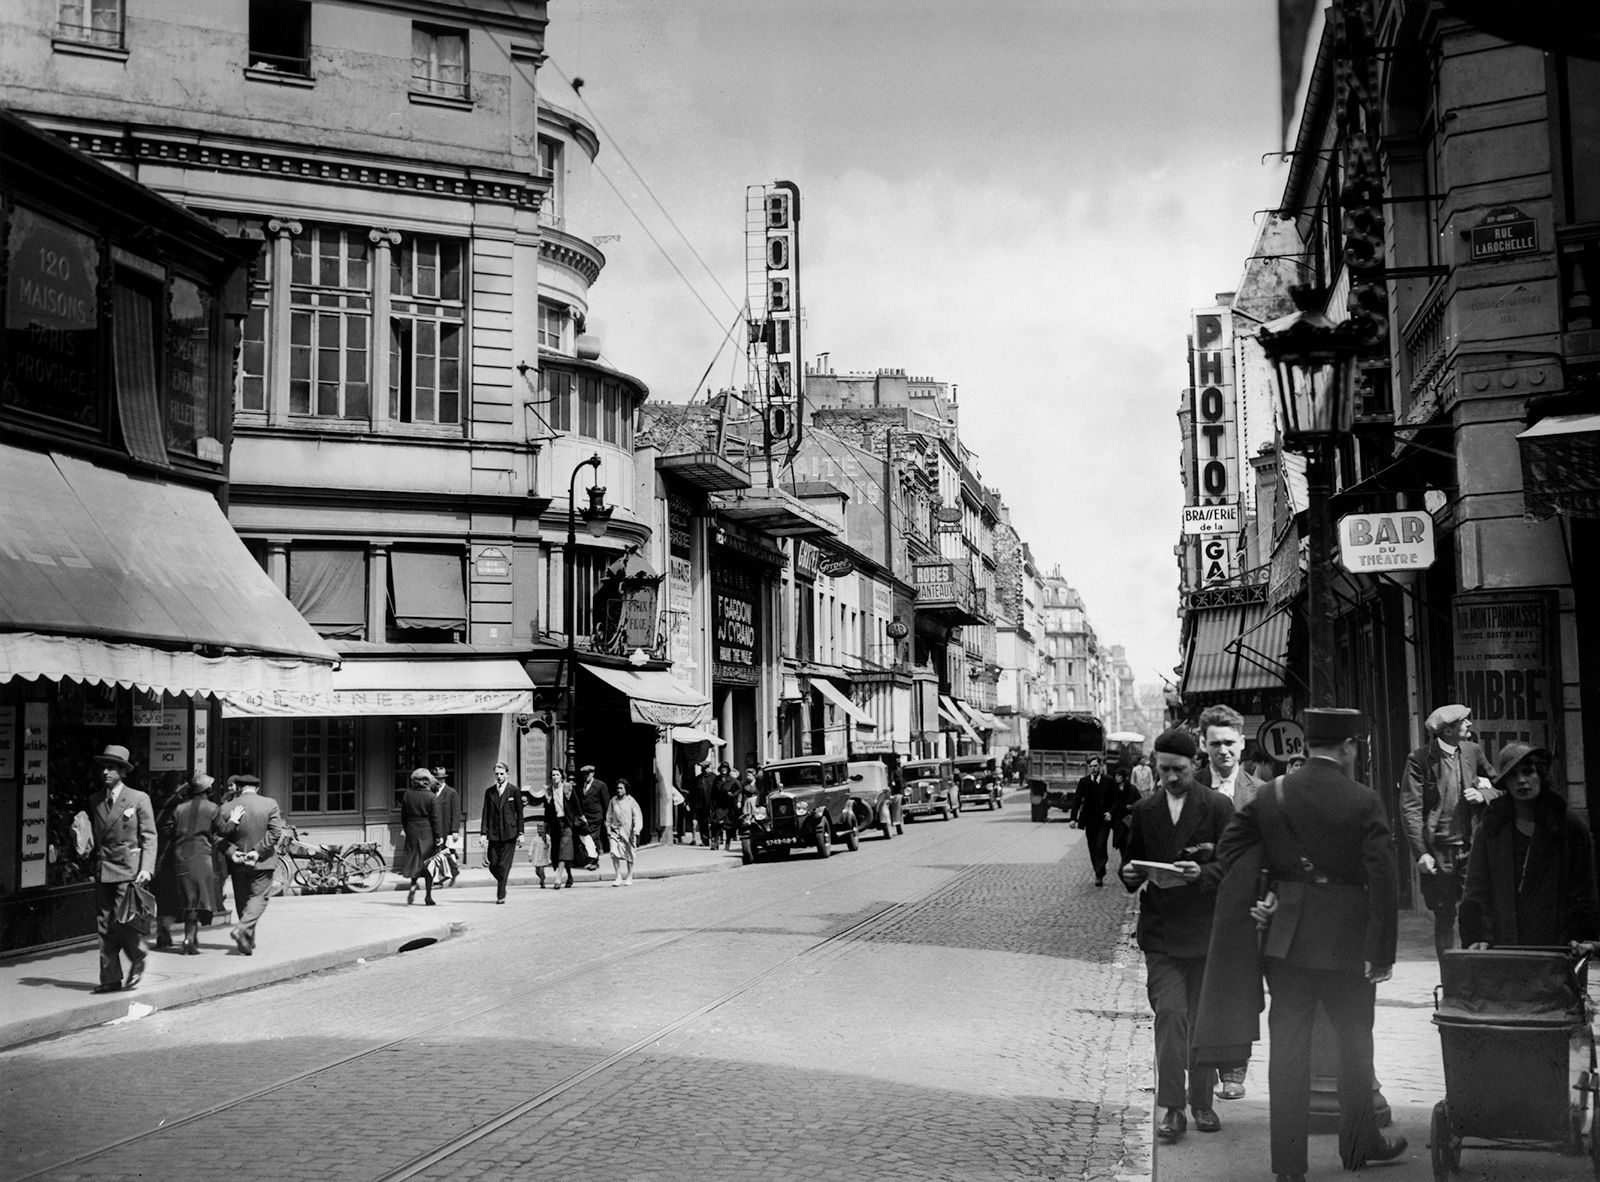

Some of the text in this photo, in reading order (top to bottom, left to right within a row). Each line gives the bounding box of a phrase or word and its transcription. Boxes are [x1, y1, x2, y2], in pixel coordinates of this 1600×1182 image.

[1494, 226, 1513, 239] RUE
[1475, 236, 1534, 255] LAROCHELLE
[40, 247, 70, 281] 120
[20, 276, 87, 324] MAISONS
[767, 192, 790, 440] BOBINO
[29, 325, 75, 356] PARIS
[16, 351, 88, 397] PROVINCE
[1195, 315, 1228, 506] PHOTO
[1185, 509, 1237, 521] BRASSERIE
[1200, 523, 1211, 531] de
[1349, 516, 1425, 546] BAR
[1379, 546, 1396, 554] DU
[1358, 553, 1418, 566] THEATRE
[916, 566, 949, 583] ROBES
[915, 584, 954, 598] MANTEAUX
[629, 600, 648, 612] PRIX
[629, 618, 646, 630] FIXE
[1470, 605, 1544, 630] MONTPARNASSE
[890, 625, 905, 635] BAR
[1486, 631, 1511, 639] GASTON
[222, 690, 416, 708] OLONNES
[162, 753, 175, 762] ICI
[27, 833, 40, 845] Rue
